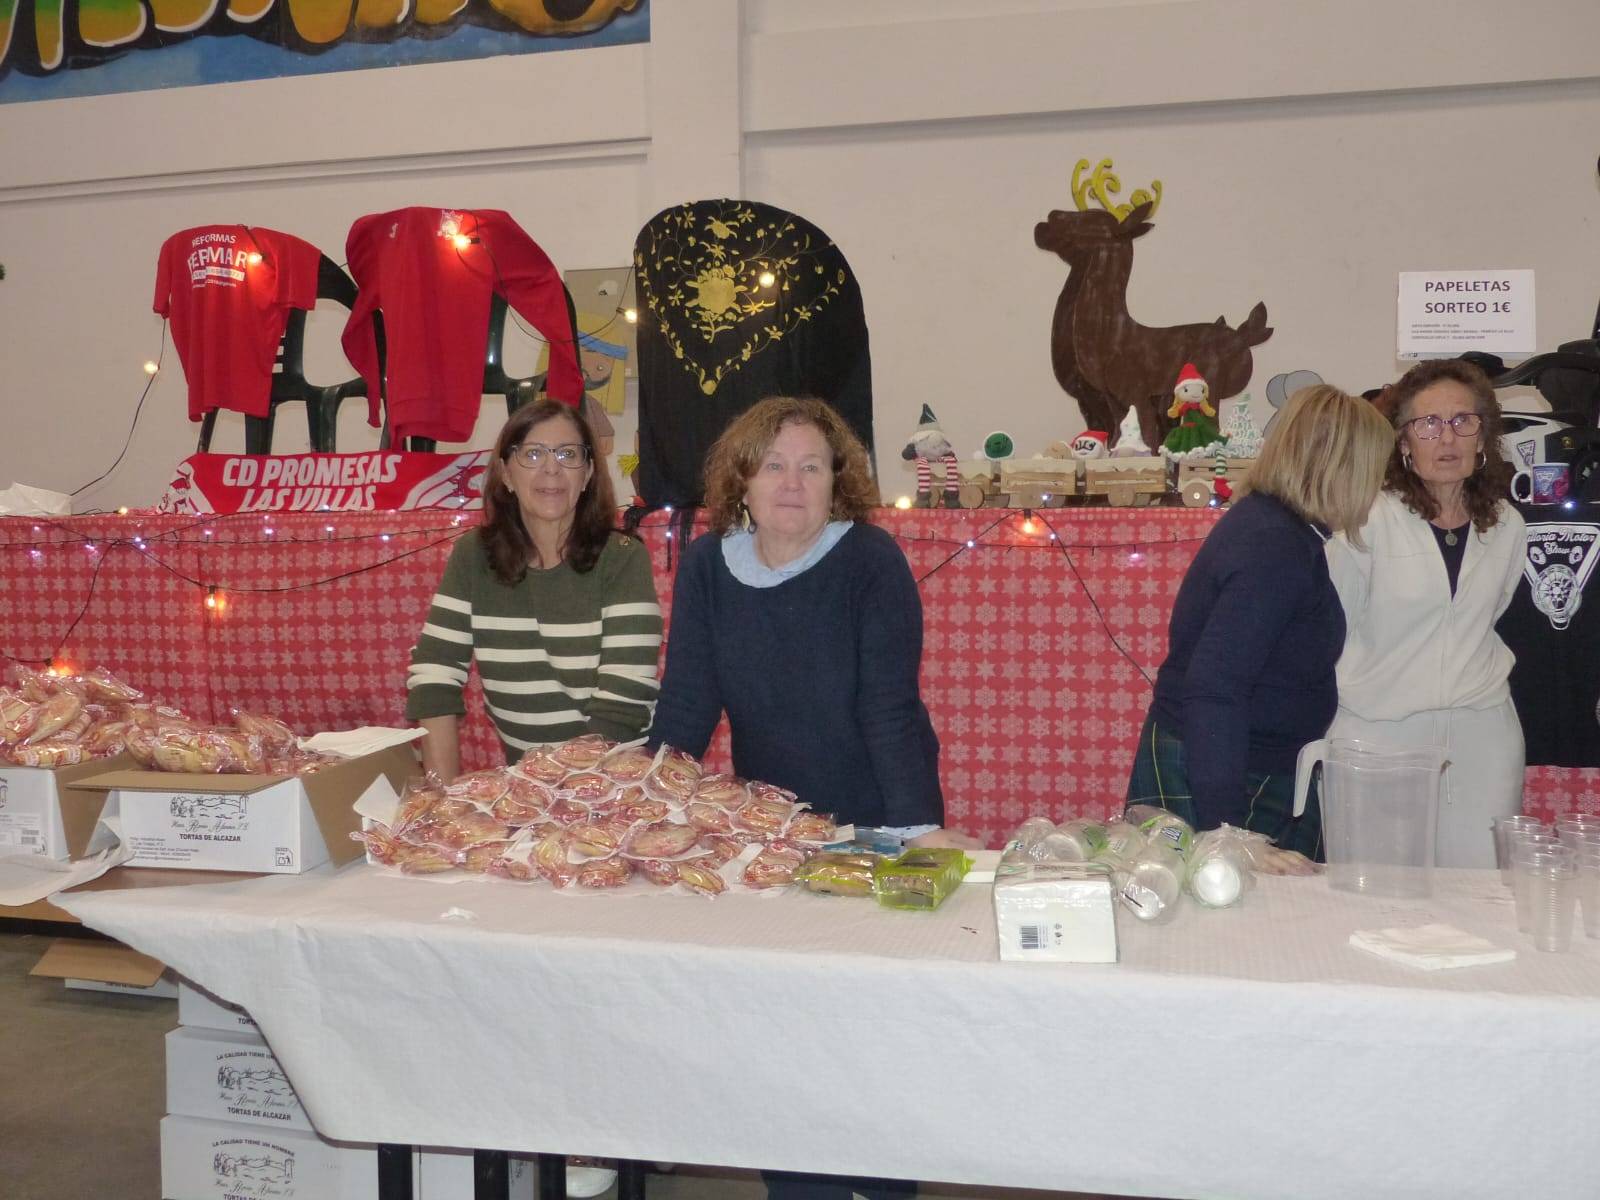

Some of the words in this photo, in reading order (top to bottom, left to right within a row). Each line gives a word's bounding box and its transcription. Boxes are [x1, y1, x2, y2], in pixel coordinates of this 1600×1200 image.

[1425, 280, 1511, 292] PAPELETAS
[1424, 302, 1487, 313] SORTEO
[1492, 301, 1511, 313] 1€
[222, 458, 258, 486] CD
[260, 454, 402, 487] PROMESAS
[236, 488, 291, 513] LAS
[289, 485, 377, 512] VILLAS
[179, 833, 203, 841] TORTAS
[213, 834, 241, 842] ALCAZAR
[227, 1106, 252, 1116] TORTAS
[252, 1109, 261, 1117] DE
[262, 1110, 292, 1121] ALCAZAR
